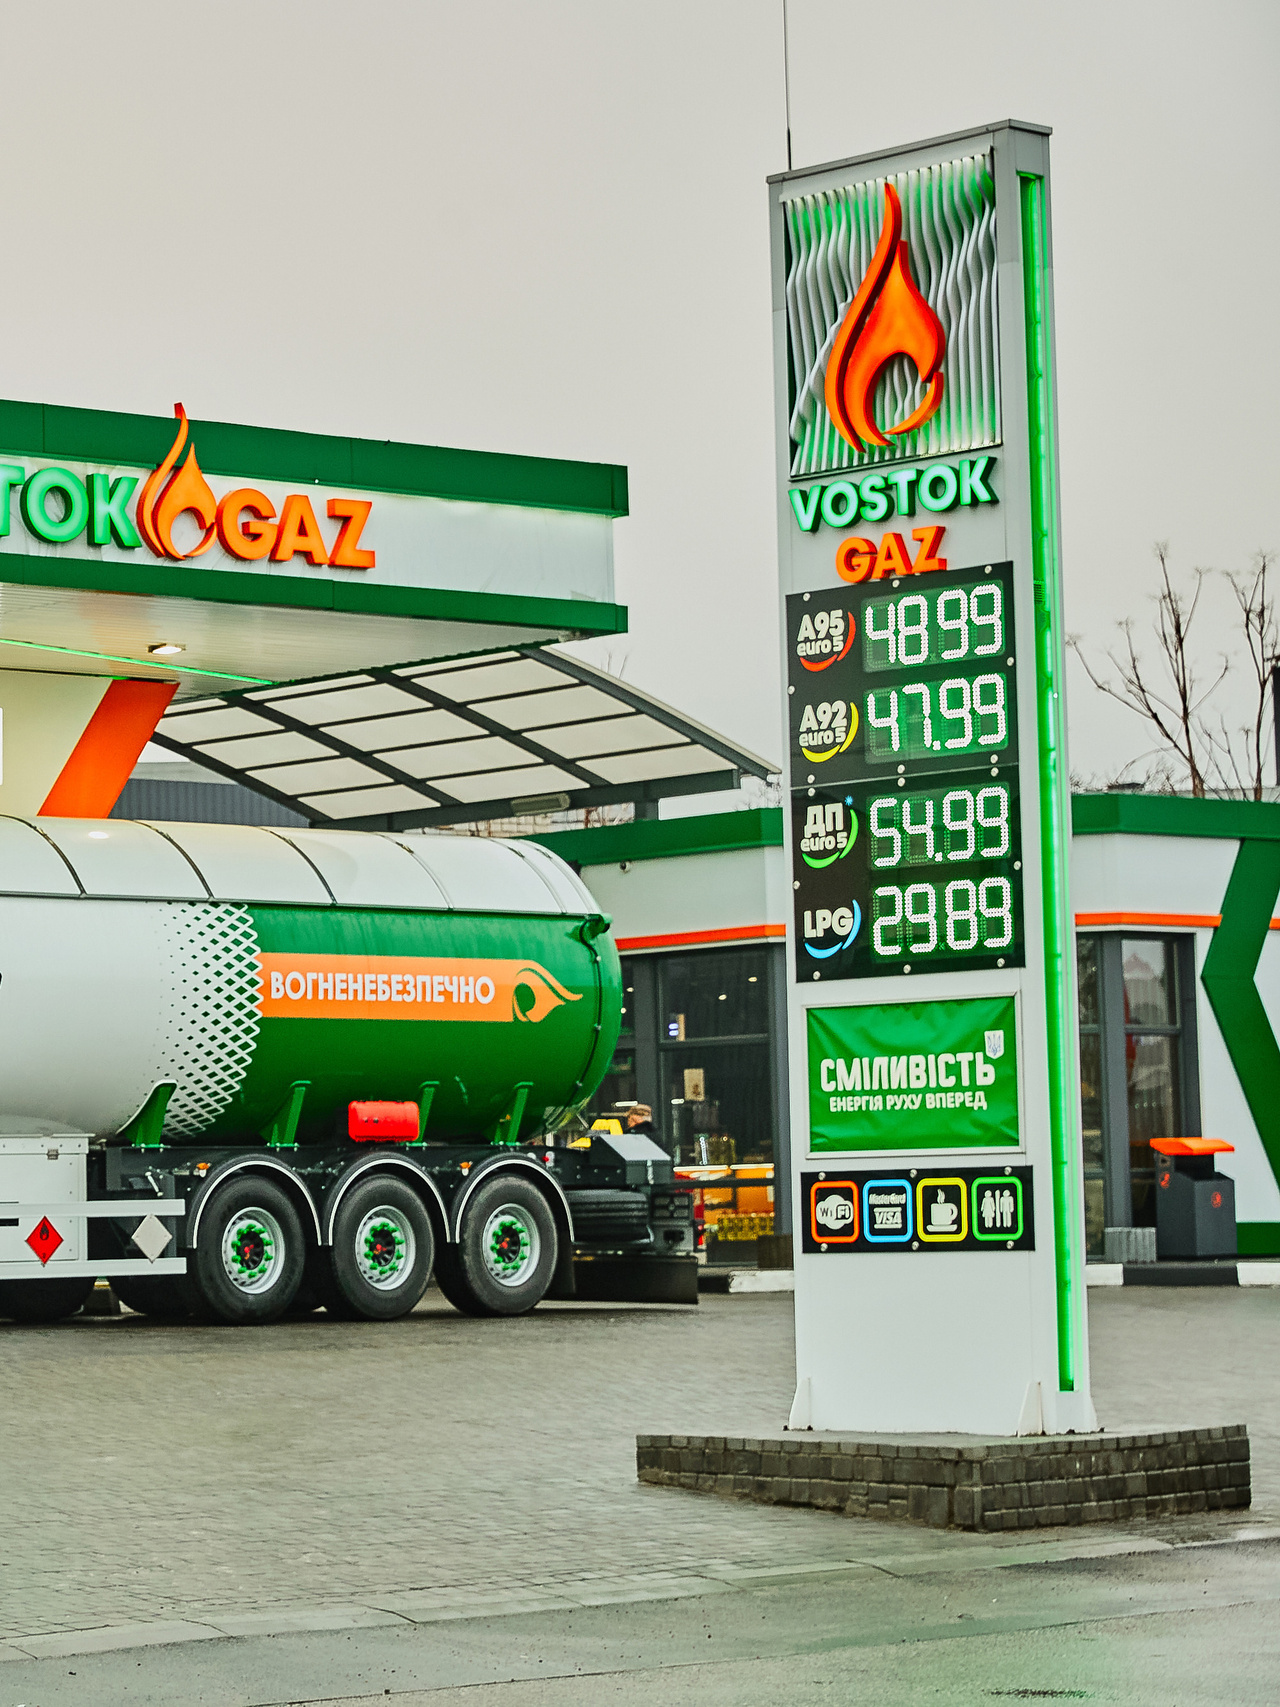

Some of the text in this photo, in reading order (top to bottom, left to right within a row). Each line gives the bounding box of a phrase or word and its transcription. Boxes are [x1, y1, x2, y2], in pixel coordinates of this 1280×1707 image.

[788, 456, 998, 533] VOSTOK
[216, 487, 376, 570] GAZ
[835, 525, 948, 584] GAZ
[797, 609, 845, 642] A95
[799, 673, 1007, 752] A92 47.99
[804, 786, 1009, 868] ДП 54.99
[803, 907, 854, 938] LPG
[271, 971, 495, 1004] ВОГНЕНЕБЕЗПЕЧНО
[820, 1052, 996, 1092] СМІЛИВІСТЬ
[829, 1091, 988, 1112] ЕНЕРГІЯ РУХУ ВПЕРЕД
[874, 1210, 902, 1224] VISA
